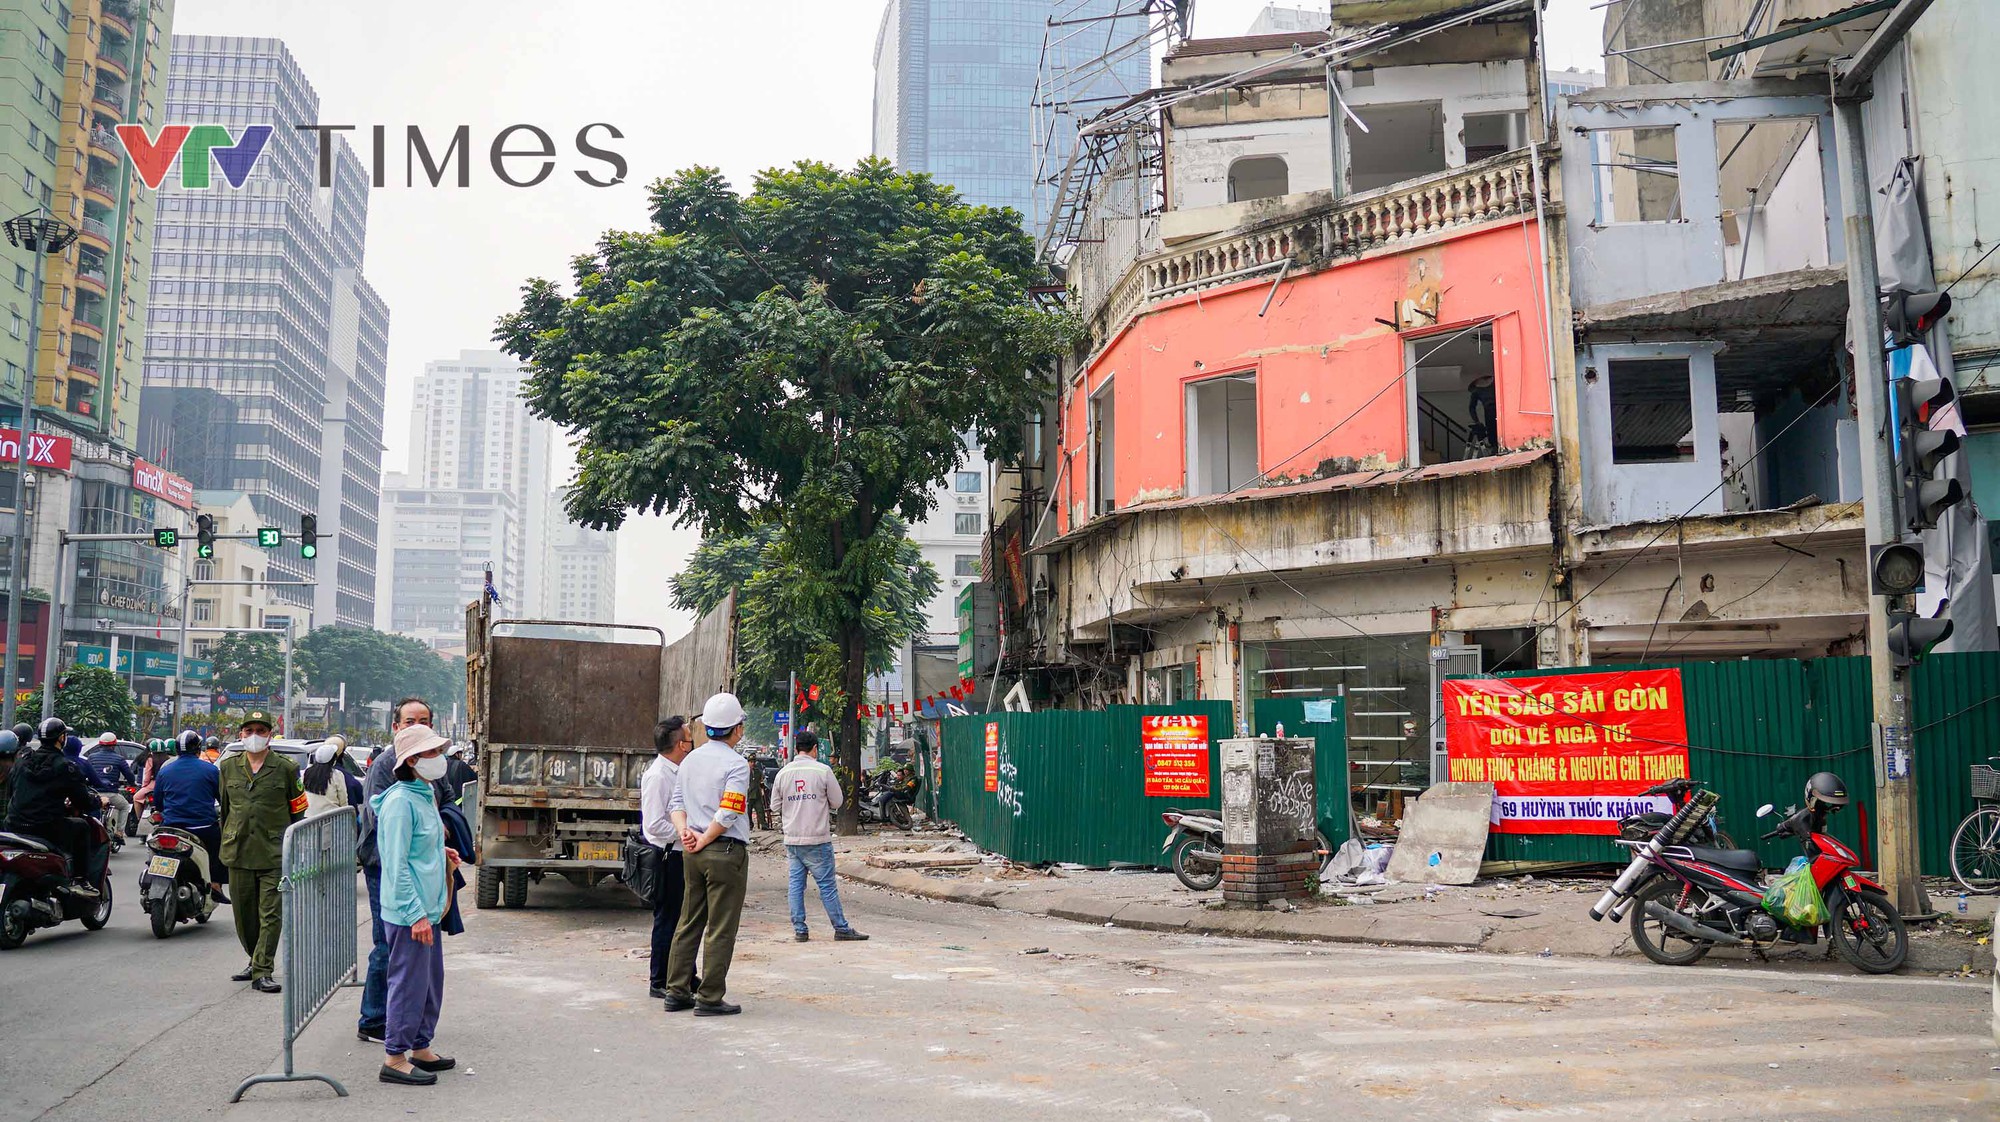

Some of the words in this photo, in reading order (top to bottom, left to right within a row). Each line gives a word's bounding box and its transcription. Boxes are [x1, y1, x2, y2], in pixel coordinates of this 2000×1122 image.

[136, 467, 164, 494] mindX
[159, 531, 175, 544] 28
[262, 531, 279, 545] 30
[1432, 649, 1447, 658] 807
[1457, 688, 1500, 716] YẾN
[1507, 688, 1555, 716] SÀO
[1563, 685, 1606, 714] SÀI
[1613, 682, 1668, 712] GÒN
[1490, 724, 1521, 745] DỜI
[1526, 722, 1550, 745] VỀ
[1555, 722, 1597, 744] NGÃ
[1450, 753, 1484, 781] HUỲNH
[1486, 752, 1515, 781] THÚC
[1517, 752, 1556, 781] KHÁNG
[1558, 757, 1568, 781] &
[1570, 747, 1618, 781] NGUYỄN
[1620, 750, 1640, 781] CHÍ
[1642, 754, 1685, 781] THANH
[1502, 801, 1517, 817] 69
[1521, 798, 1566, 818] HUỲNH
[1569, 798, 1603, 818] THÚC
[1607, 798, 1654, 818] KHÁNG
